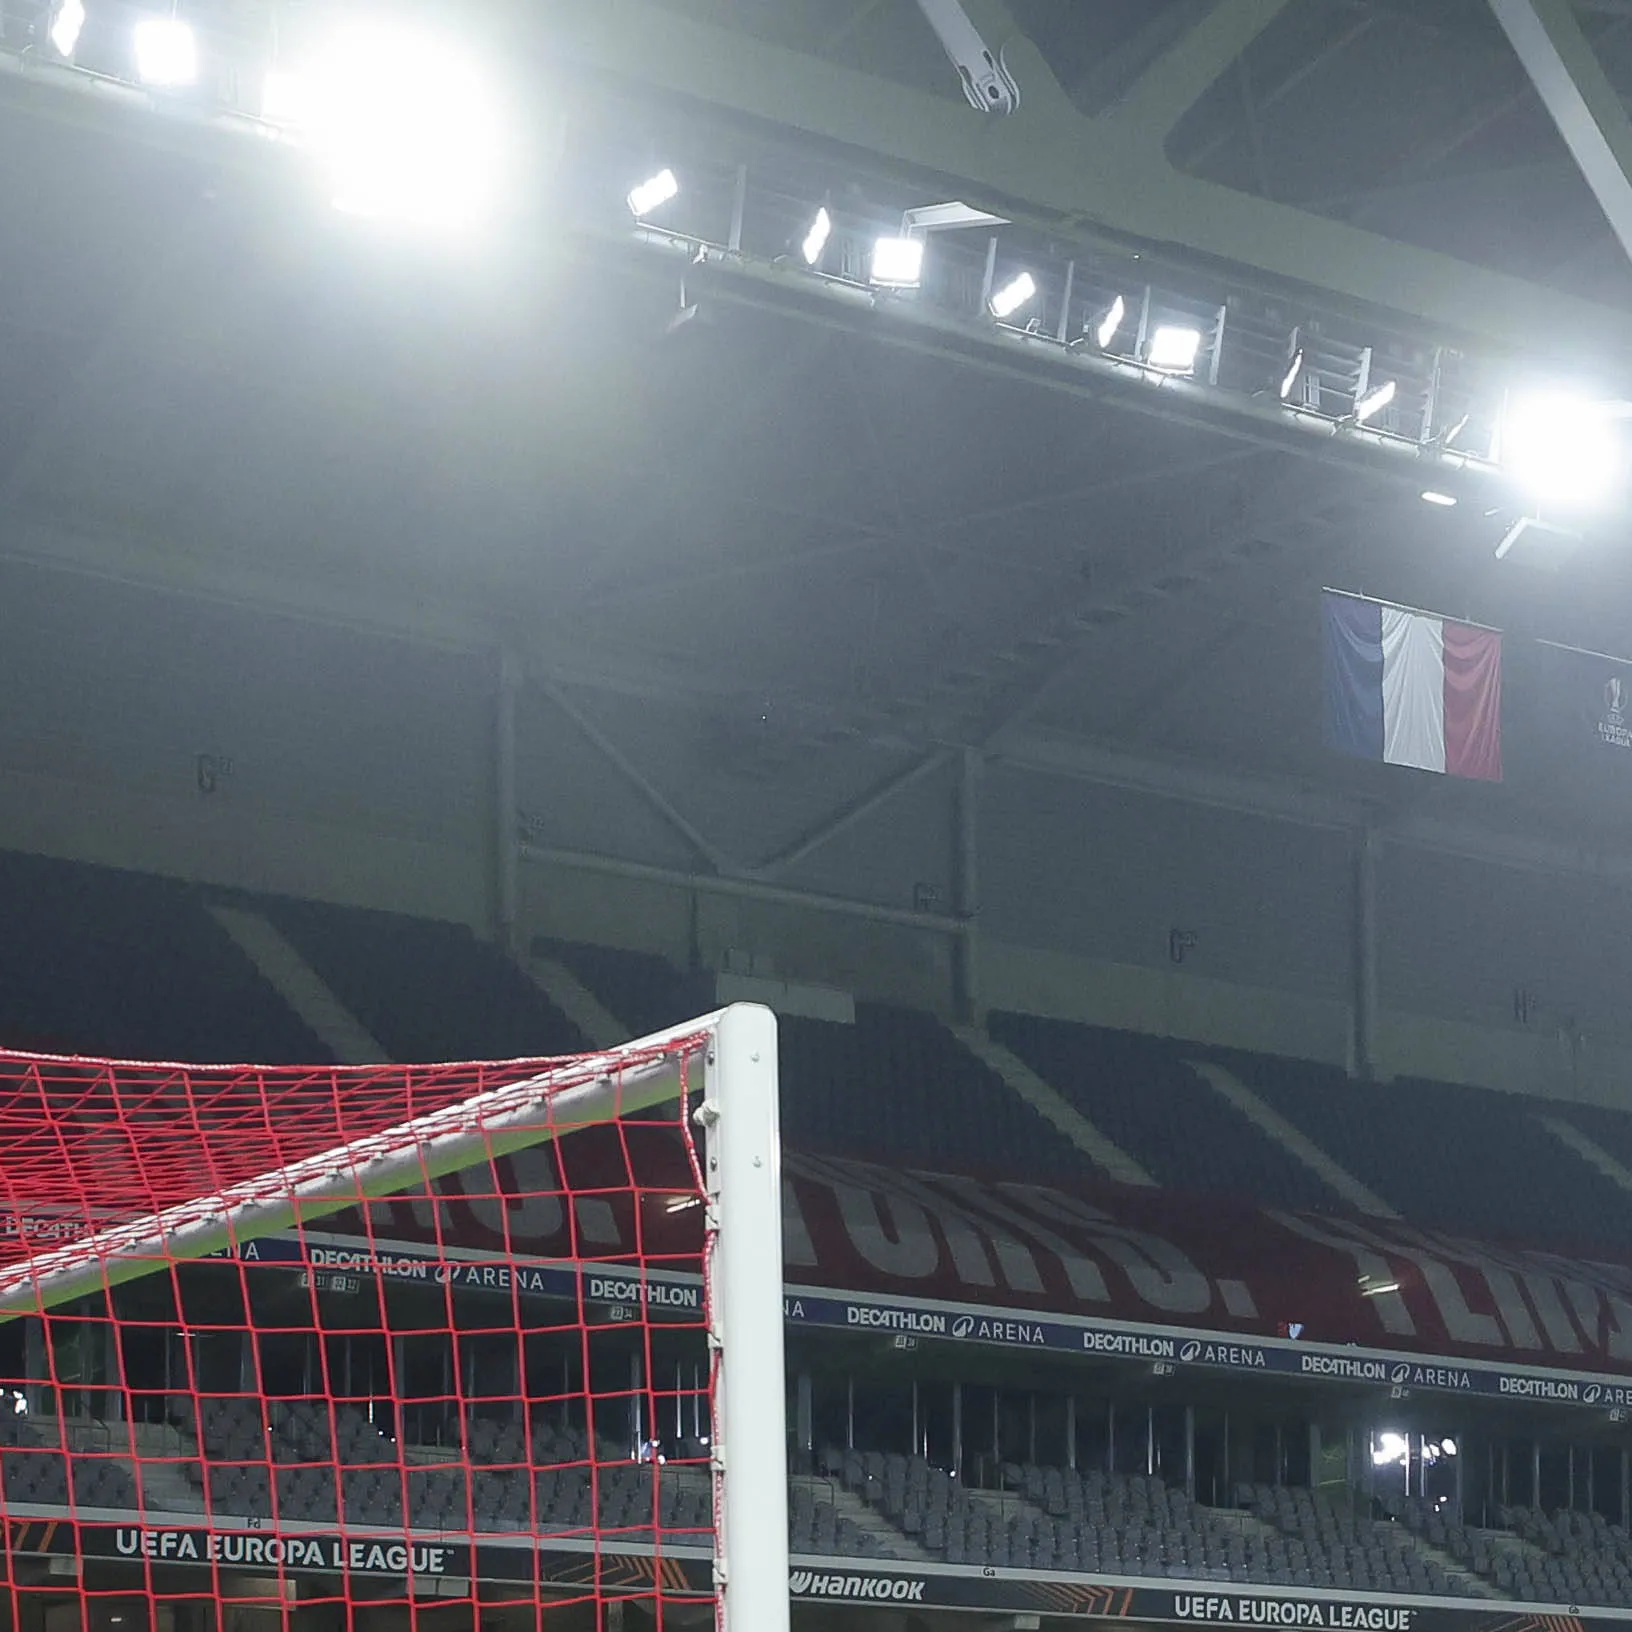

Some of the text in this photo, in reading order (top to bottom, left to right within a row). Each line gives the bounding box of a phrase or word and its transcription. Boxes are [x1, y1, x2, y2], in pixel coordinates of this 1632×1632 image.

[310, 1247, 544, 1291] DECATHLON ARENA
[590, 1279, 697, 1308] DECATHLON
[846, 1306, 1045, 1344] DECATHLON ARENA
[1083, 1331, 1266, 1367] DECATHLON ARENA
[1301, 1355, 1471, 1389] DECATHLON ARENA
[1499, 1376, 1578, 1400] DECATHLON
[116, 1528, 198, 1559] UEFA
[206, 1534, 325, 1566] EUROPA
[983, 1567, 995, 1577] Ga
[1174, 1595, 1234, 1622] UEFA
[1238, 1600, 1324, 1627] EUROPA
